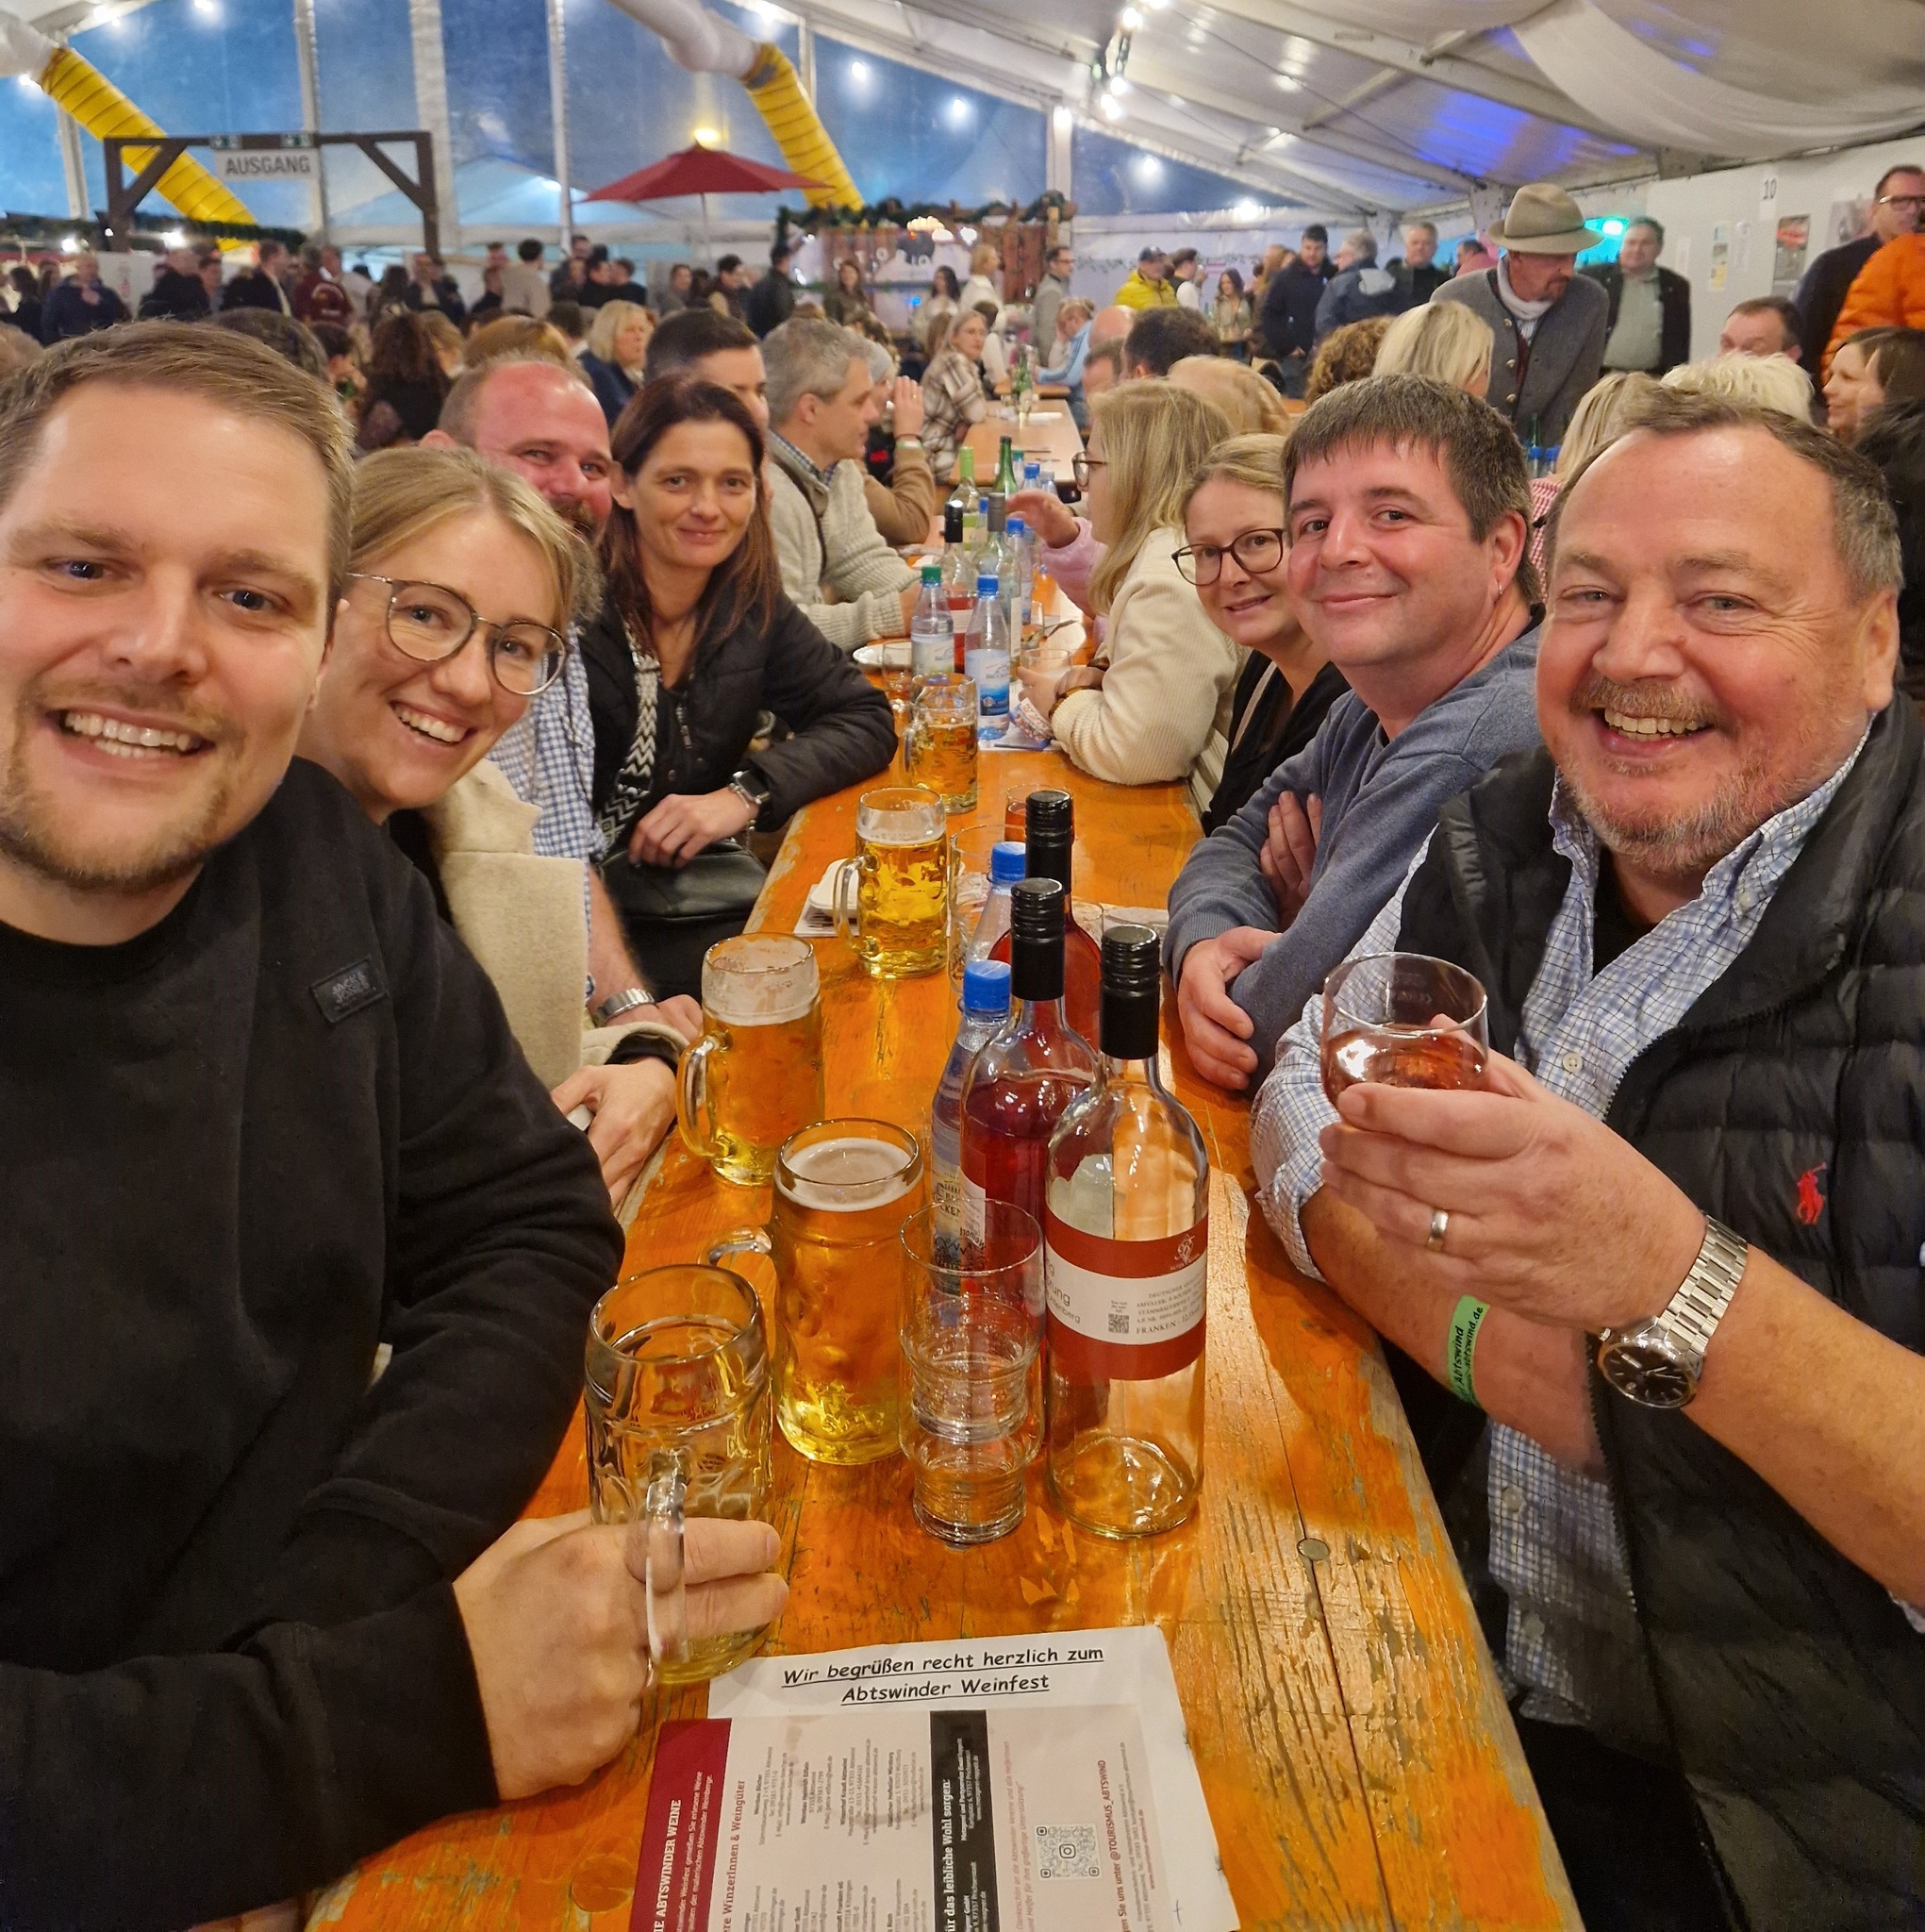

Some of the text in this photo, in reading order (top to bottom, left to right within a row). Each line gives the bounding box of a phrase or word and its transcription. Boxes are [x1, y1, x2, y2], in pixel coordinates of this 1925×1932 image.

[225, 156, 311, 175] AUSGANG
[1762, 177, 1778, 200] 10
[1136, 1321, 1176, 1335] FRANKEN
[784, 1647, 1104, 1685] Wir begrüßen recht herzlich zum
[841, 1674, 1050, 1703] Abtswinder Weinfest
[1098, 1760, 1120, 1860] @TOURISMUS_ABTSWIND
[655, 1839, 676, 1917] ABTSWINDER
[666, 1799, 681, 1837] WEINE
[722, 1843, 739, 1915] WinzerInnen
[731, 1779, 745, 1831] Weingüter
[941, 1779, 956, 1932] ür das leibliche Wohl sorgen:
[1113, 1862, 1122, 1885] unter
[1117, 1887, 1125, 1902] uns
[1118, 1904, 1127, 1917] Sie
